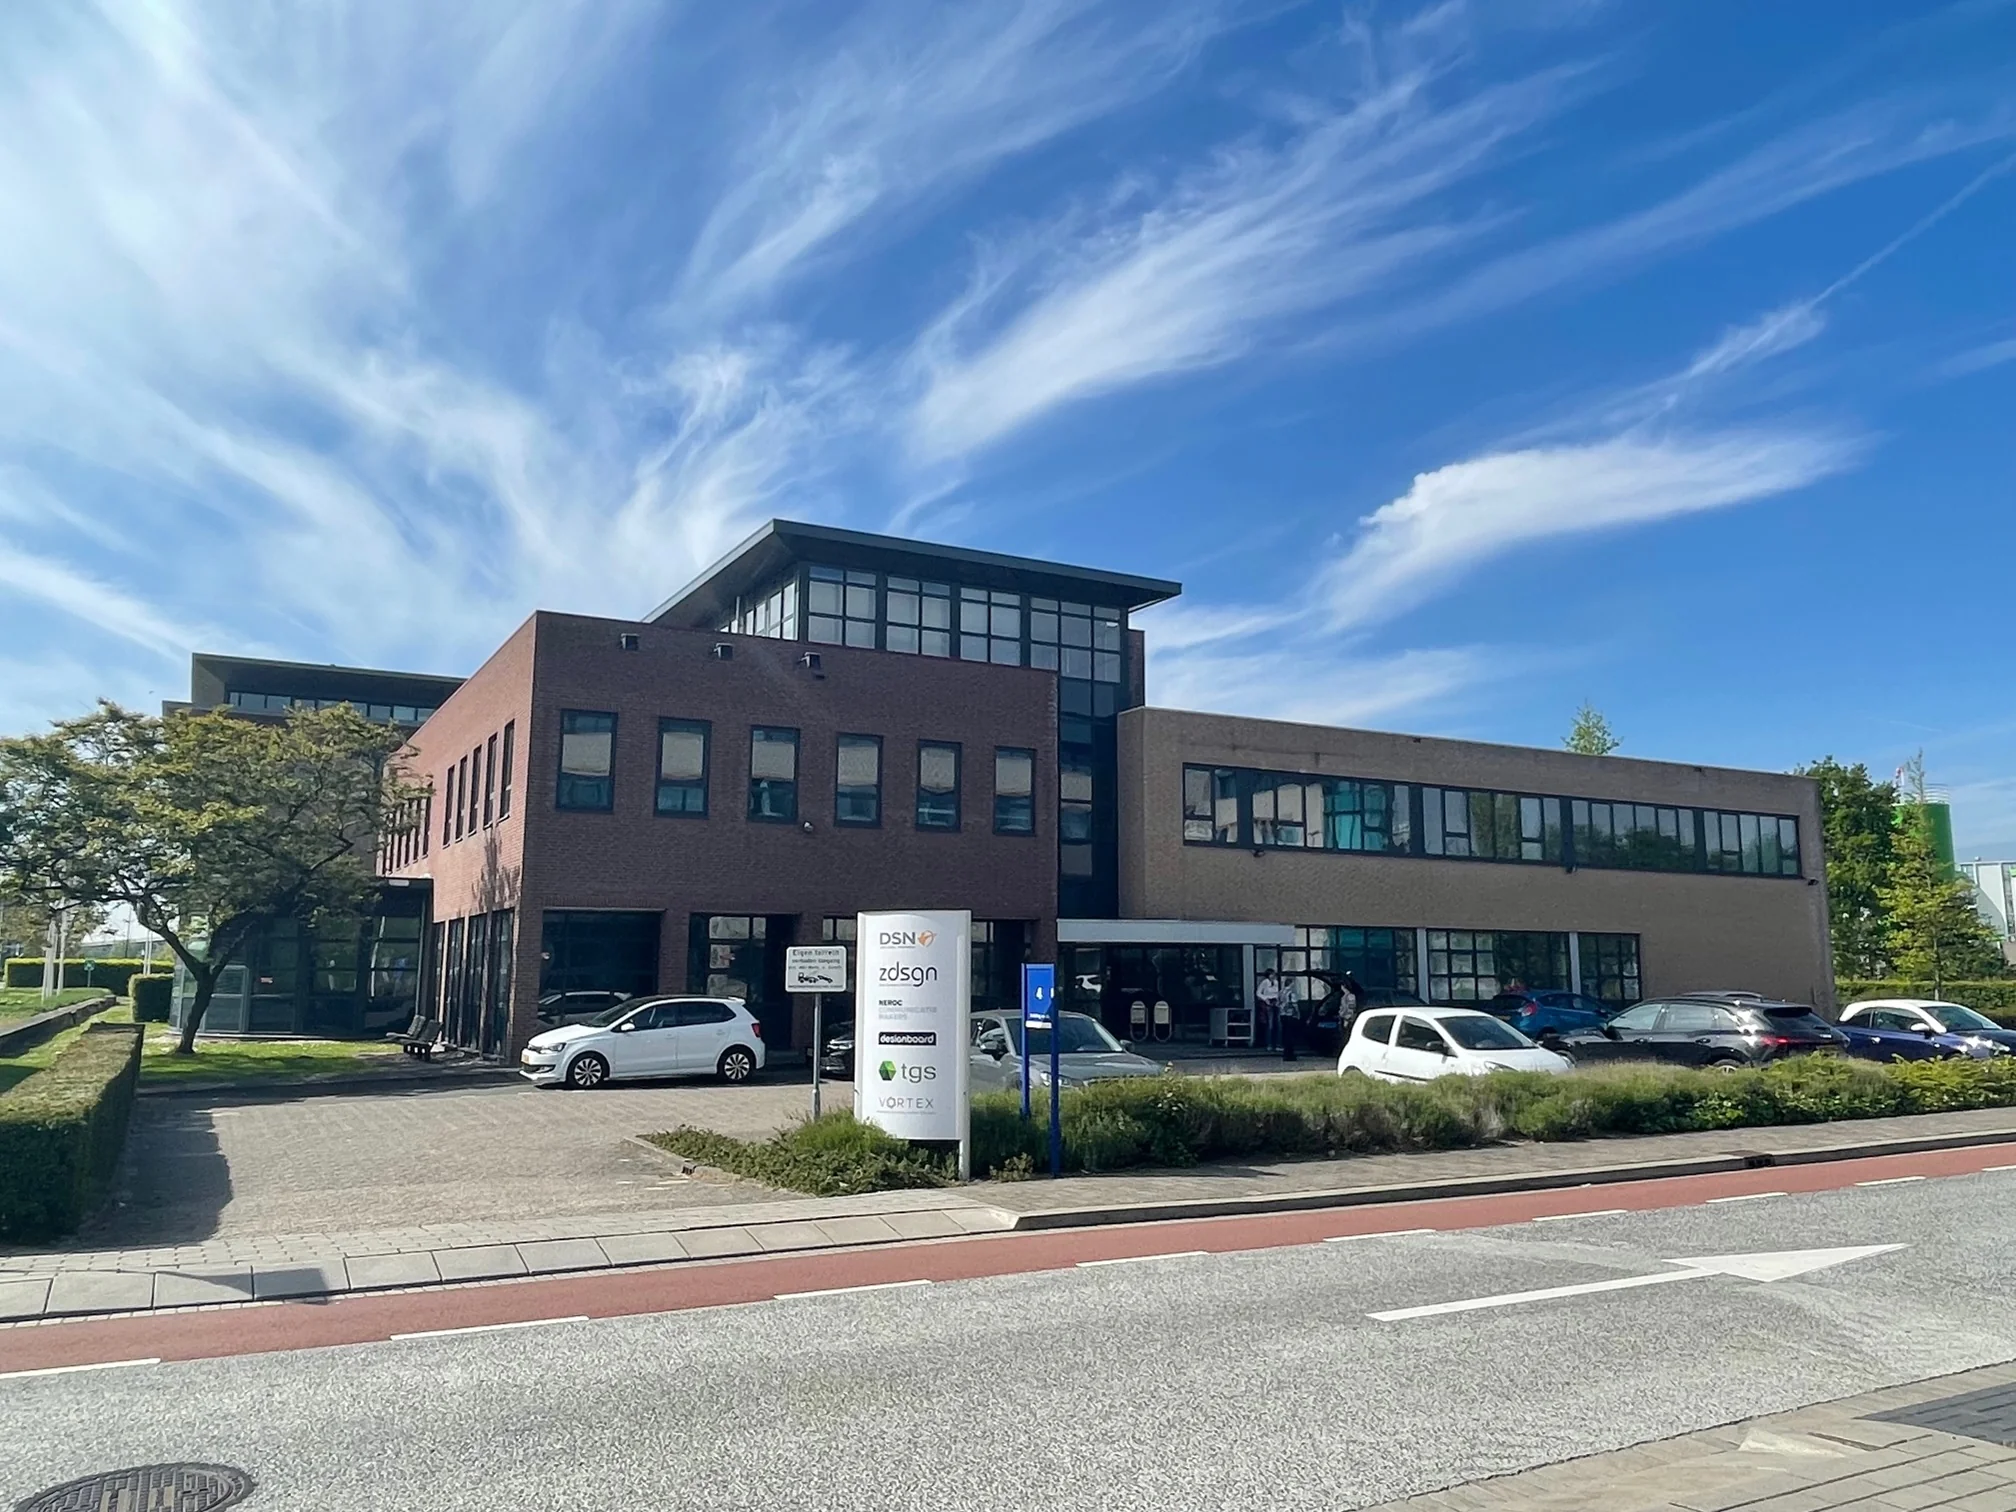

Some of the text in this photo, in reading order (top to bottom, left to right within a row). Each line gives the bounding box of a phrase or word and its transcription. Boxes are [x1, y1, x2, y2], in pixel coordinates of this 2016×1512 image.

[879, 931, 916, 945] DSN
[878, 961, 938, 987] zdsgn
[901, 1063, 937, 1083] tgs
[878, 1096, 934, 1109] VORTEX
